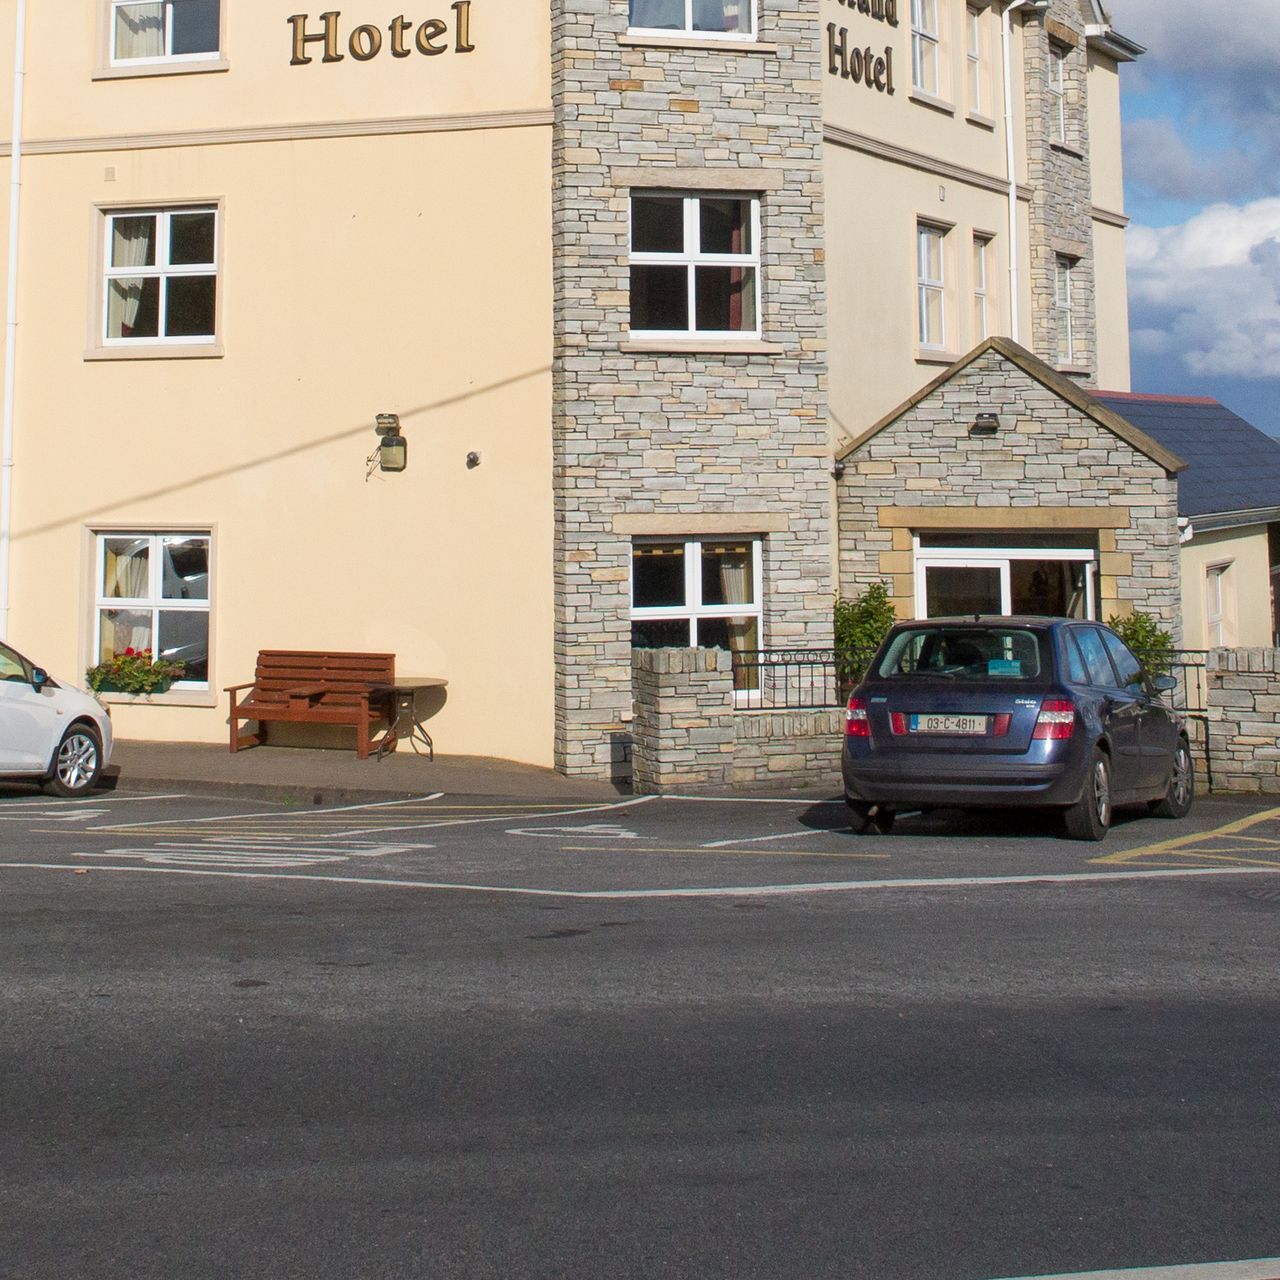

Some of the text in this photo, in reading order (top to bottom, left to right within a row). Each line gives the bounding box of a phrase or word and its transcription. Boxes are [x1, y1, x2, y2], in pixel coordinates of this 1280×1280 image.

[287, 0, 475, 66] Hotel
[827, 22, 895, 96] Hotel
[926, 717, 976, 730] 03-C-4811
